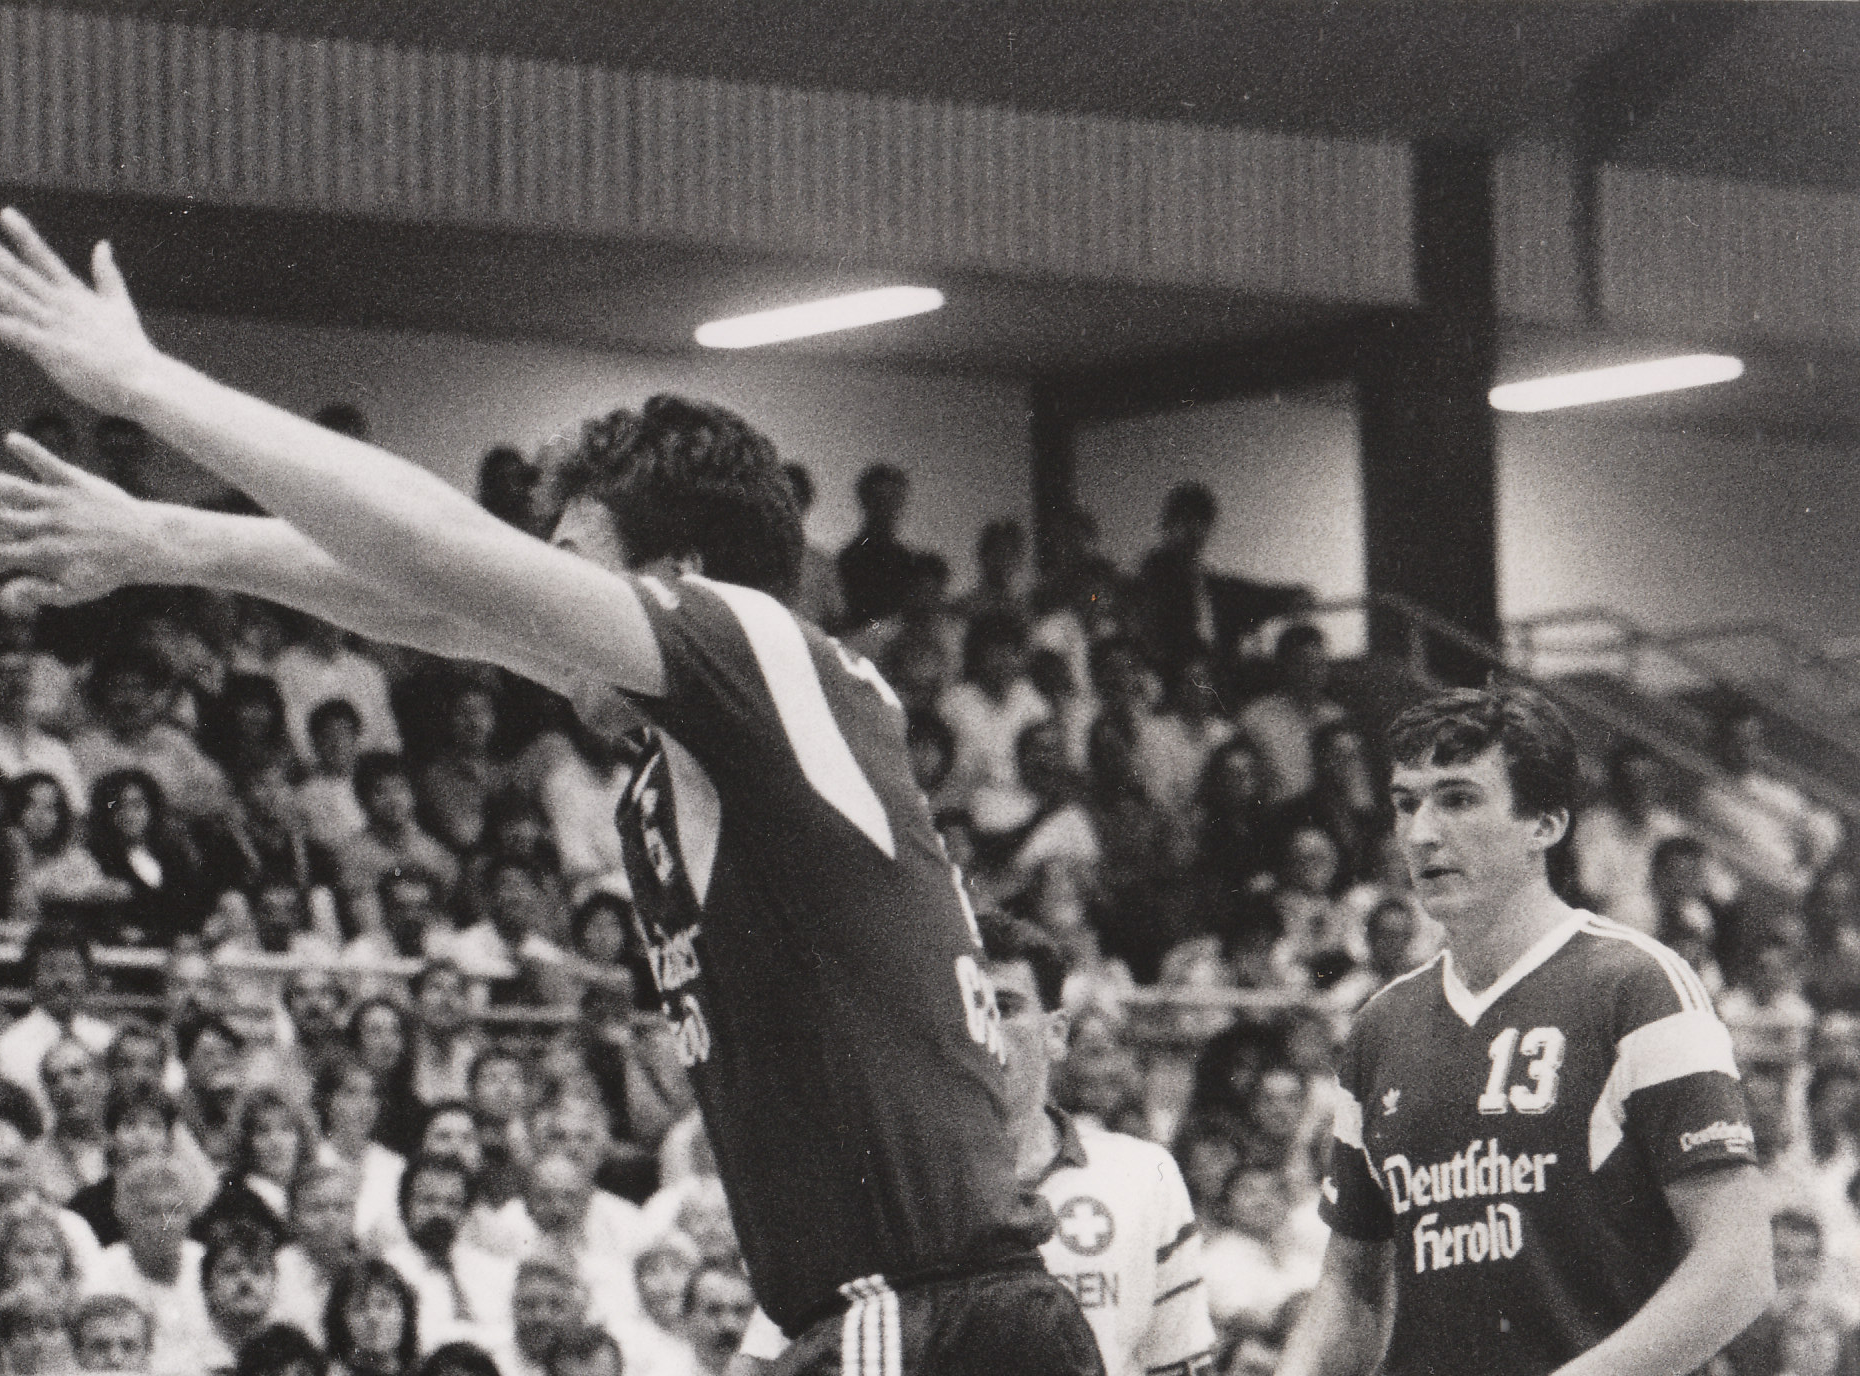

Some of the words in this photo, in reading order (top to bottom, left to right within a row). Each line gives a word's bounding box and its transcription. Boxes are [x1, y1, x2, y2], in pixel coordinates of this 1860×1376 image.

[1478, 1026, 1566, 1115] 13
[1383, 1138, 1558, 1215] Deutscher
[1413, 1203, 1523, 1275] Herold
